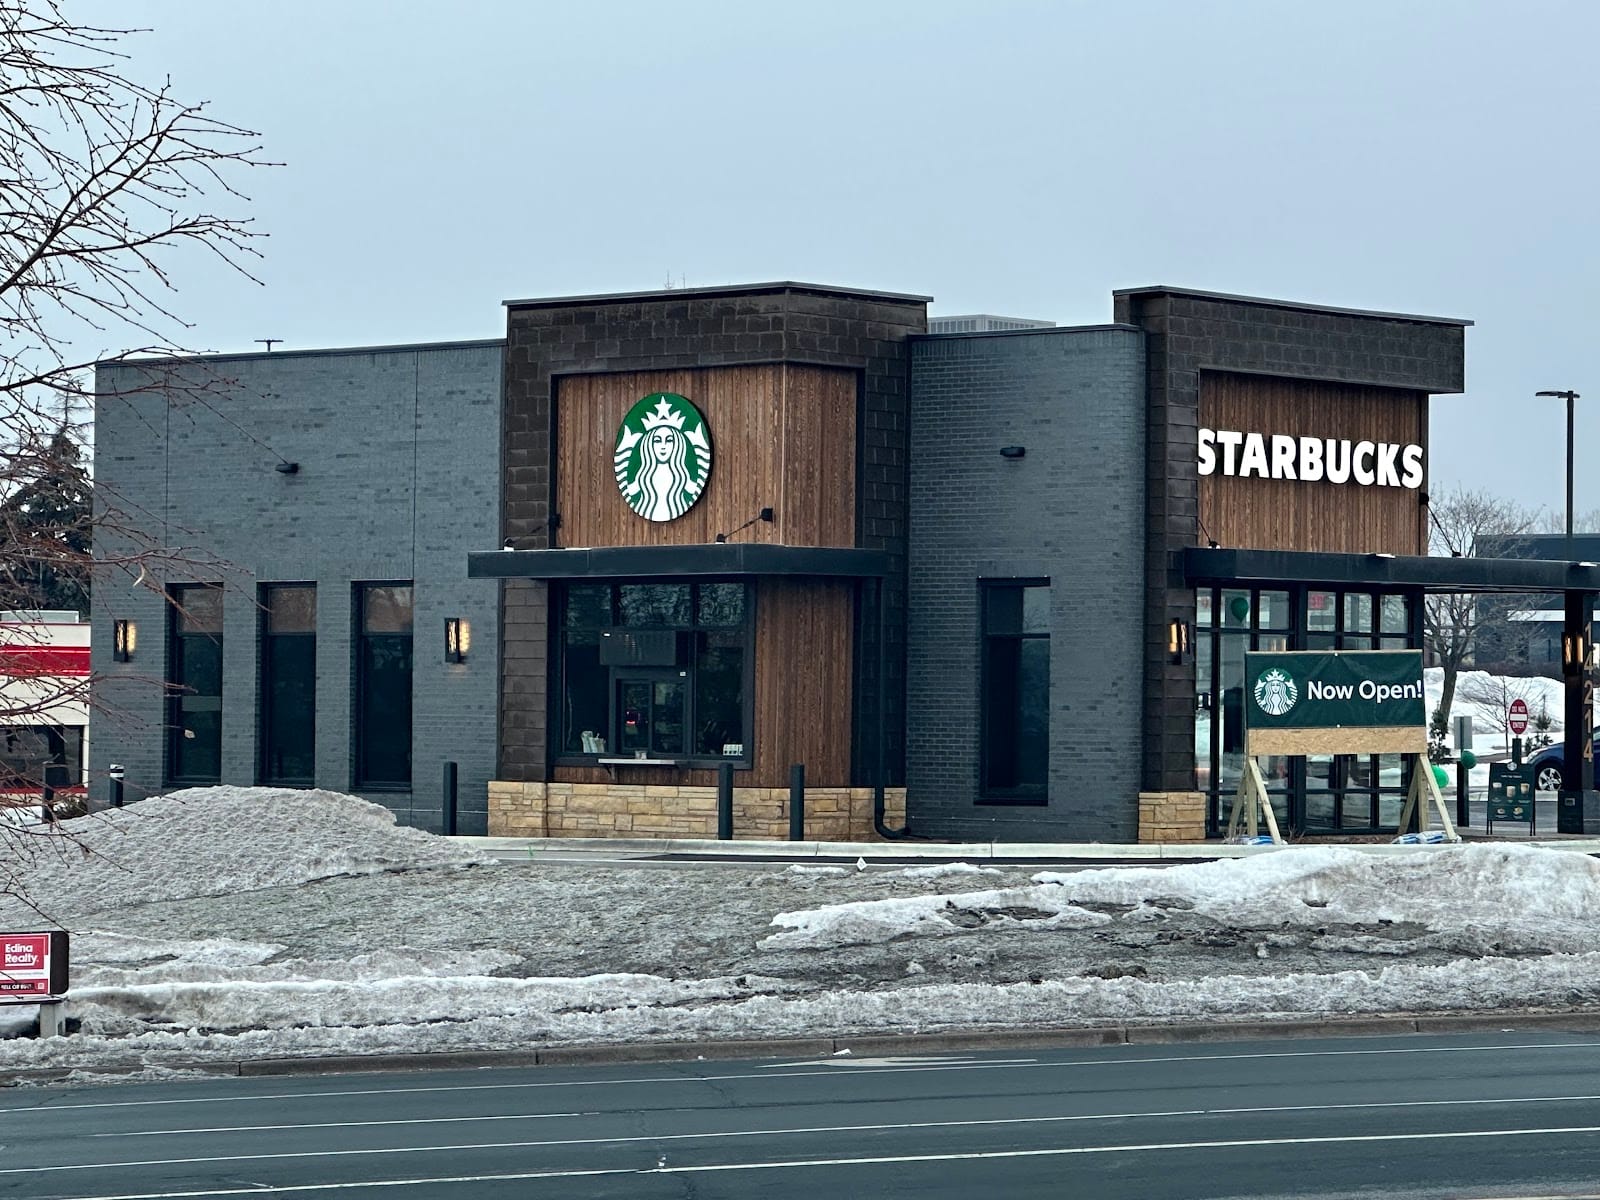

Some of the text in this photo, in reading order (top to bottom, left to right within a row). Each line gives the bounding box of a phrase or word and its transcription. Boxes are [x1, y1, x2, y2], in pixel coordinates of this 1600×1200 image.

[1198, 428, 1424, 488] STARBUCKS
[1308, 680, 1423, 703] Now Open!
[1583, 621, 1594, 762] 14214
[1512, 721, 1525, 729] ENTER
[5, 943, 33, 953] Edina
